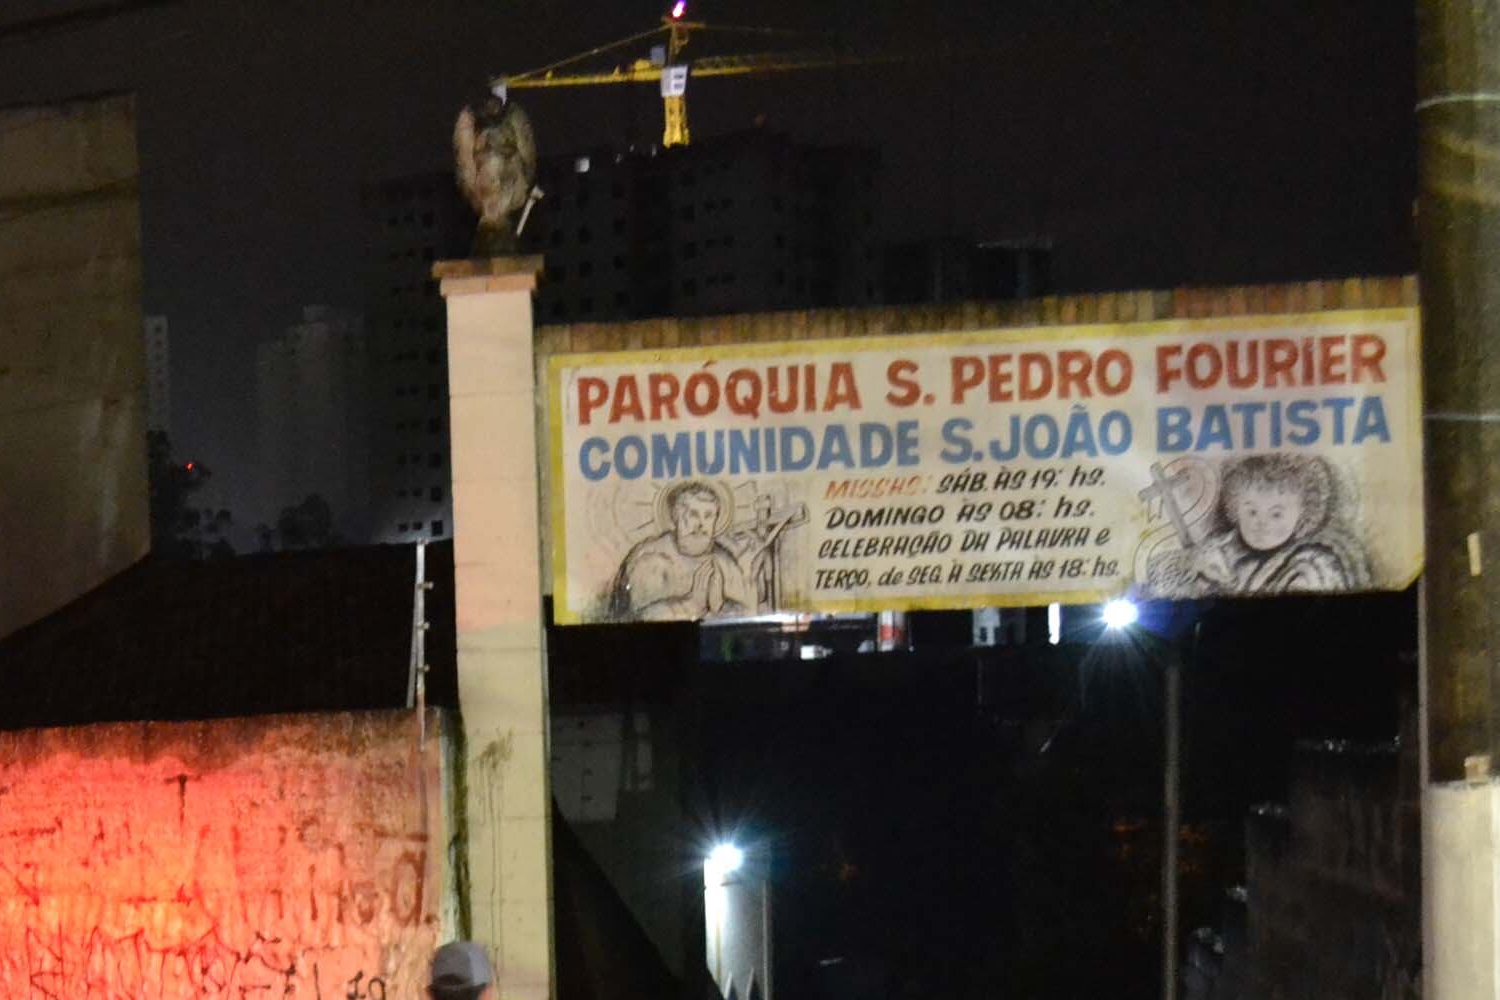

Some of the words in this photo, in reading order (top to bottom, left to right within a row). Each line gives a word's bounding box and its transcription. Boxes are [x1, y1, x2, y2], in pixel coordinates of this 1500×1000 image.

[577, 359, 863, 425] PARÓQUIA
[885, 358, 935, 408] S.
[950, 348, 1134, 406] PEDRO
[1156, 334, 1388, 395] FOURIER
[579, 419, 921, 482] COMUNIDADE
[1156, 396, 1392, 454] BATISTA
[825, 504, 945, 531] DOMINGO
[817, 529, 952, 560] CELEBRAÇÃO
[960, 530, 991, 553] DA
[998, 526, 1090, 552] PALAVRA
[1094, 526, 1112, 547] e
[877, 566, 903, 587] de
[965, 559, 1022, 584] SEXTA
